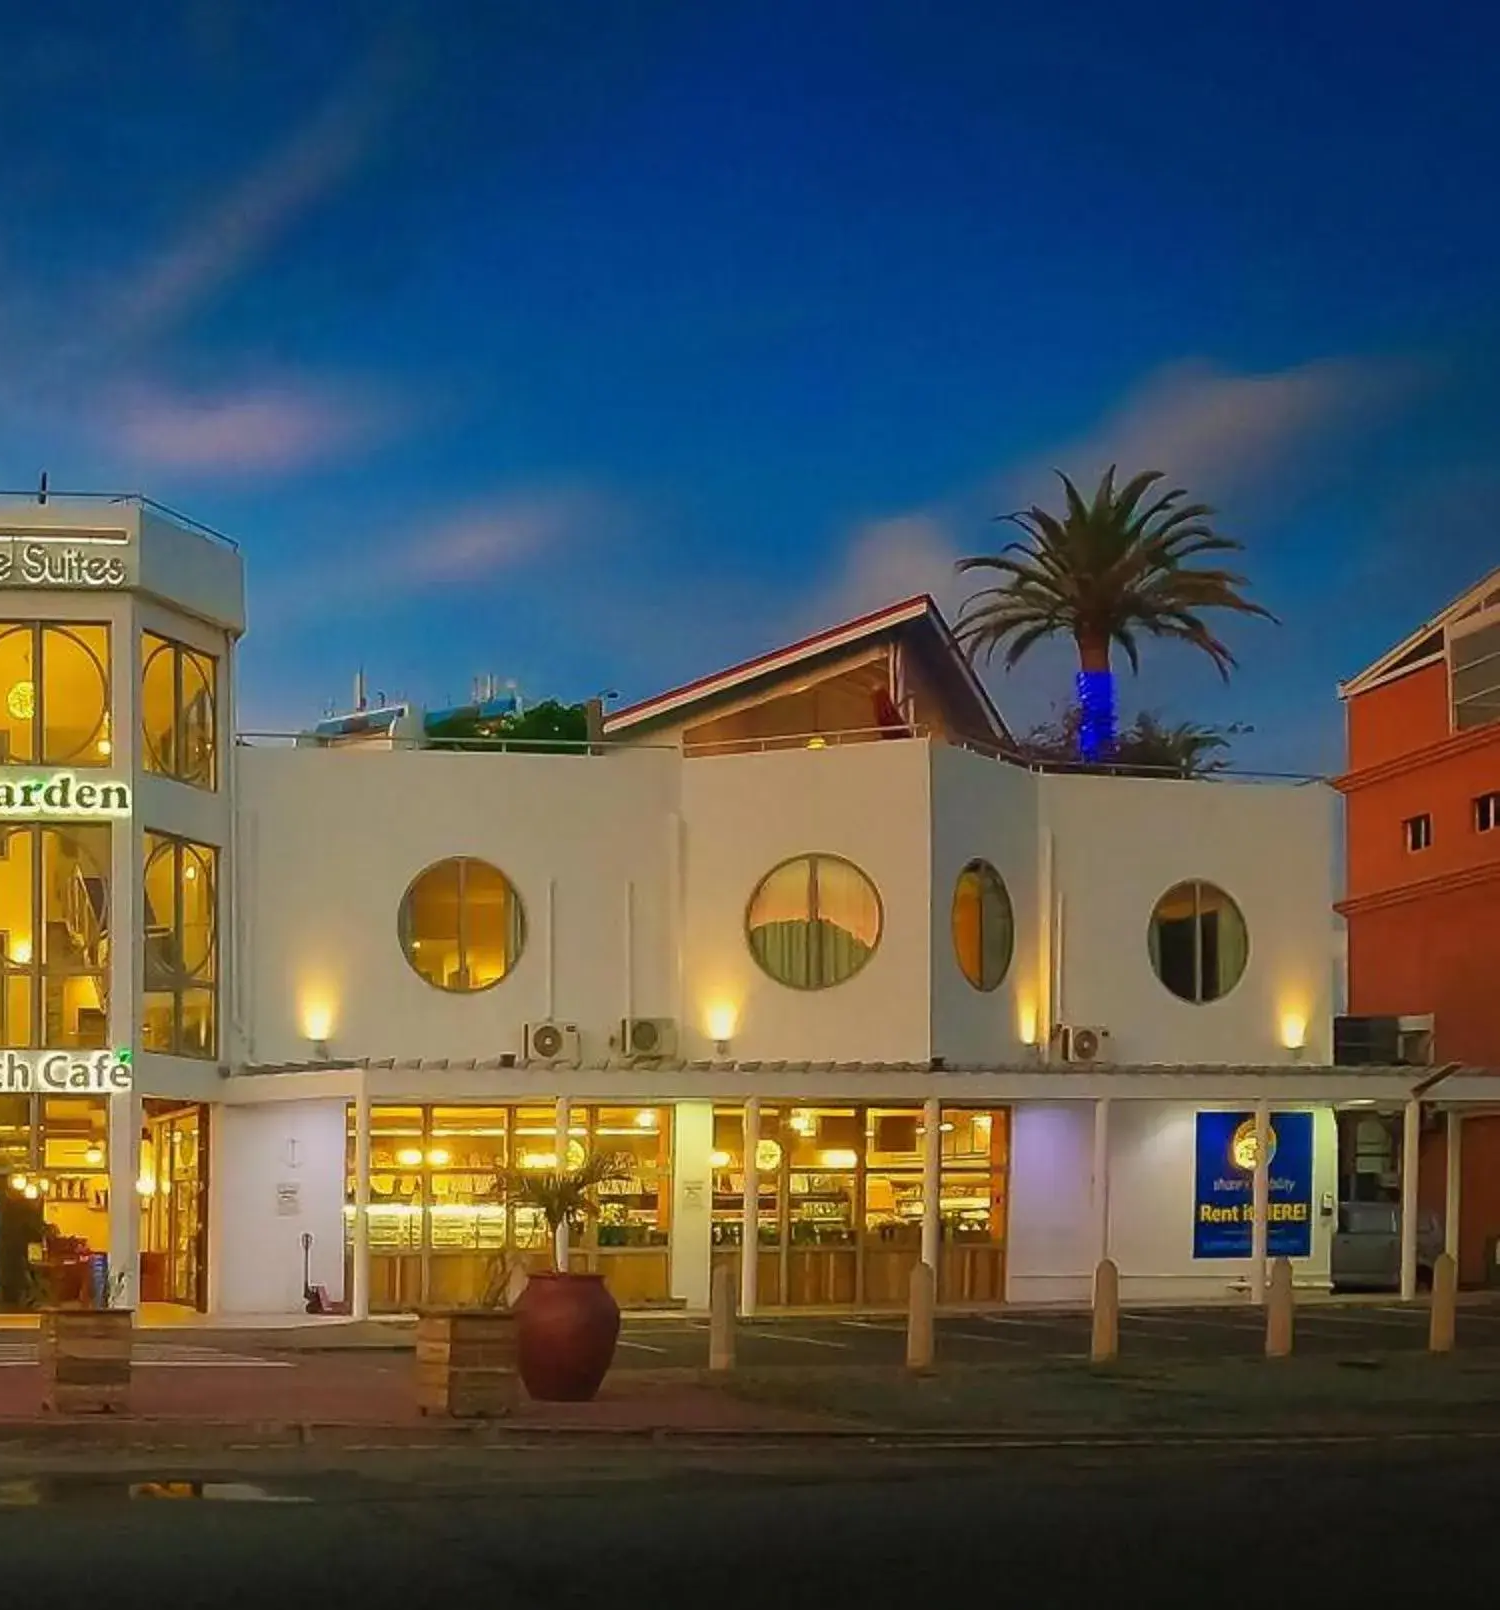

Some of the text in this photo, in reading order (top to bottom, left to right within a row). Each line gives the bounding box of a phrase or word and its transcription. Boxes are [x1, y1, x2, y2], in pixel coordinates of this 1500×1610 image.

[22, 543, 126, 585] Suites
[43, 1051, 132, 1088] Café
[1200, 1204, 1239, 1222] Rent
